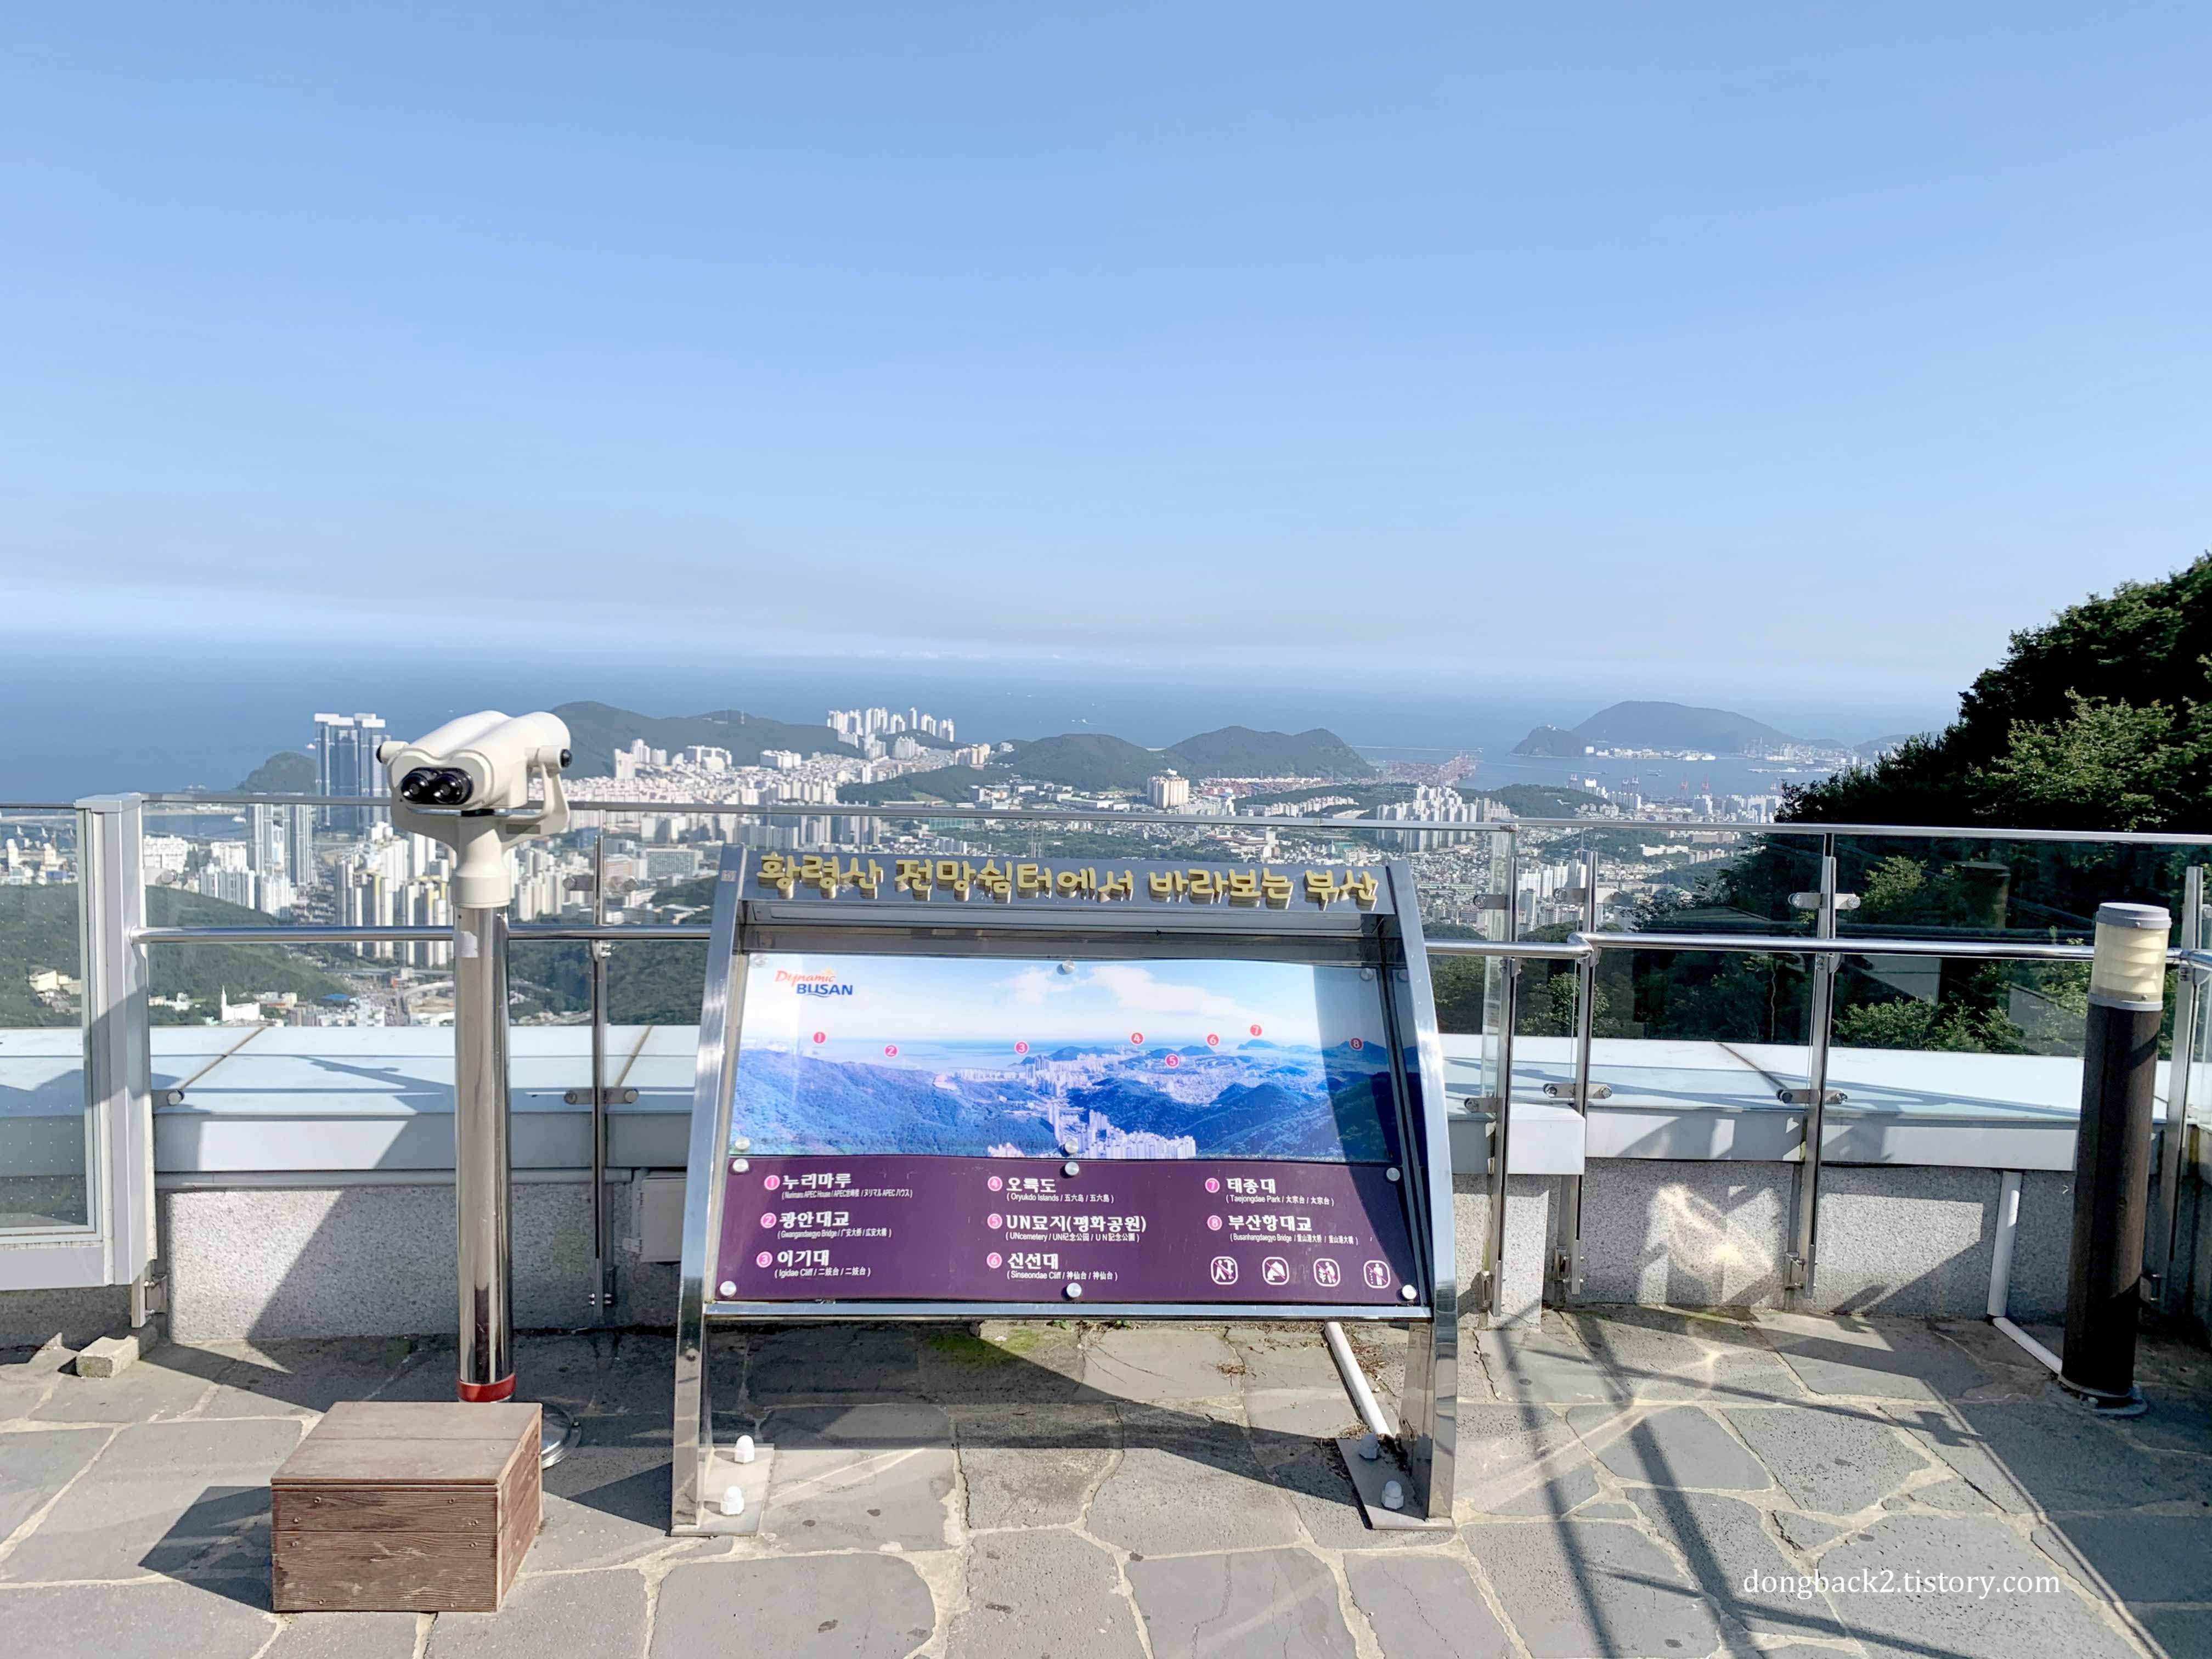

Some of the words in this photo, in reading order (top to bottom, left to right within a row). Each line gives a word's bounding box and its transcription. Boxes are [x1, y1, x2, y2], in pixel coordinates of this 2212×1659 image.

[757, 851, 882, 896] 황령산
[895, 857, 1133, 900] 전망쉼터에서
[1149, 868, 1293, 905] 바라보는
[1305, 869, 1378, 909] 부산
[775, 970, 836, 986] Dynamic
[796, 983, 853, 995] BUSAN
[782, 1173, 851, 1189] 누리마루
[1006, 1177, 1056, 1193] 오륙도
[1226, 1178, 1276, 1194] 태종대
[1011, 1193, 1036, 1201] Oryukdo
[1230, 1194, 1265, 1204] Taejongdae
[779, 1211, 849, 1229] 광안대교
[1006, 1215, 1147, 1233] UN묘지(평화공원)
[1228, 1215, 1312, 1232] 부산항대교
[1277, 1234, 1292, 1243] Bridge
[777, 1250, 830, 1267] 이기대
[1007, 1253, 1058, 1270] 신선대
[779, 1268, 799, 1278] Igidae
[1011, 1271, 1047, 1279] Sinseondae
